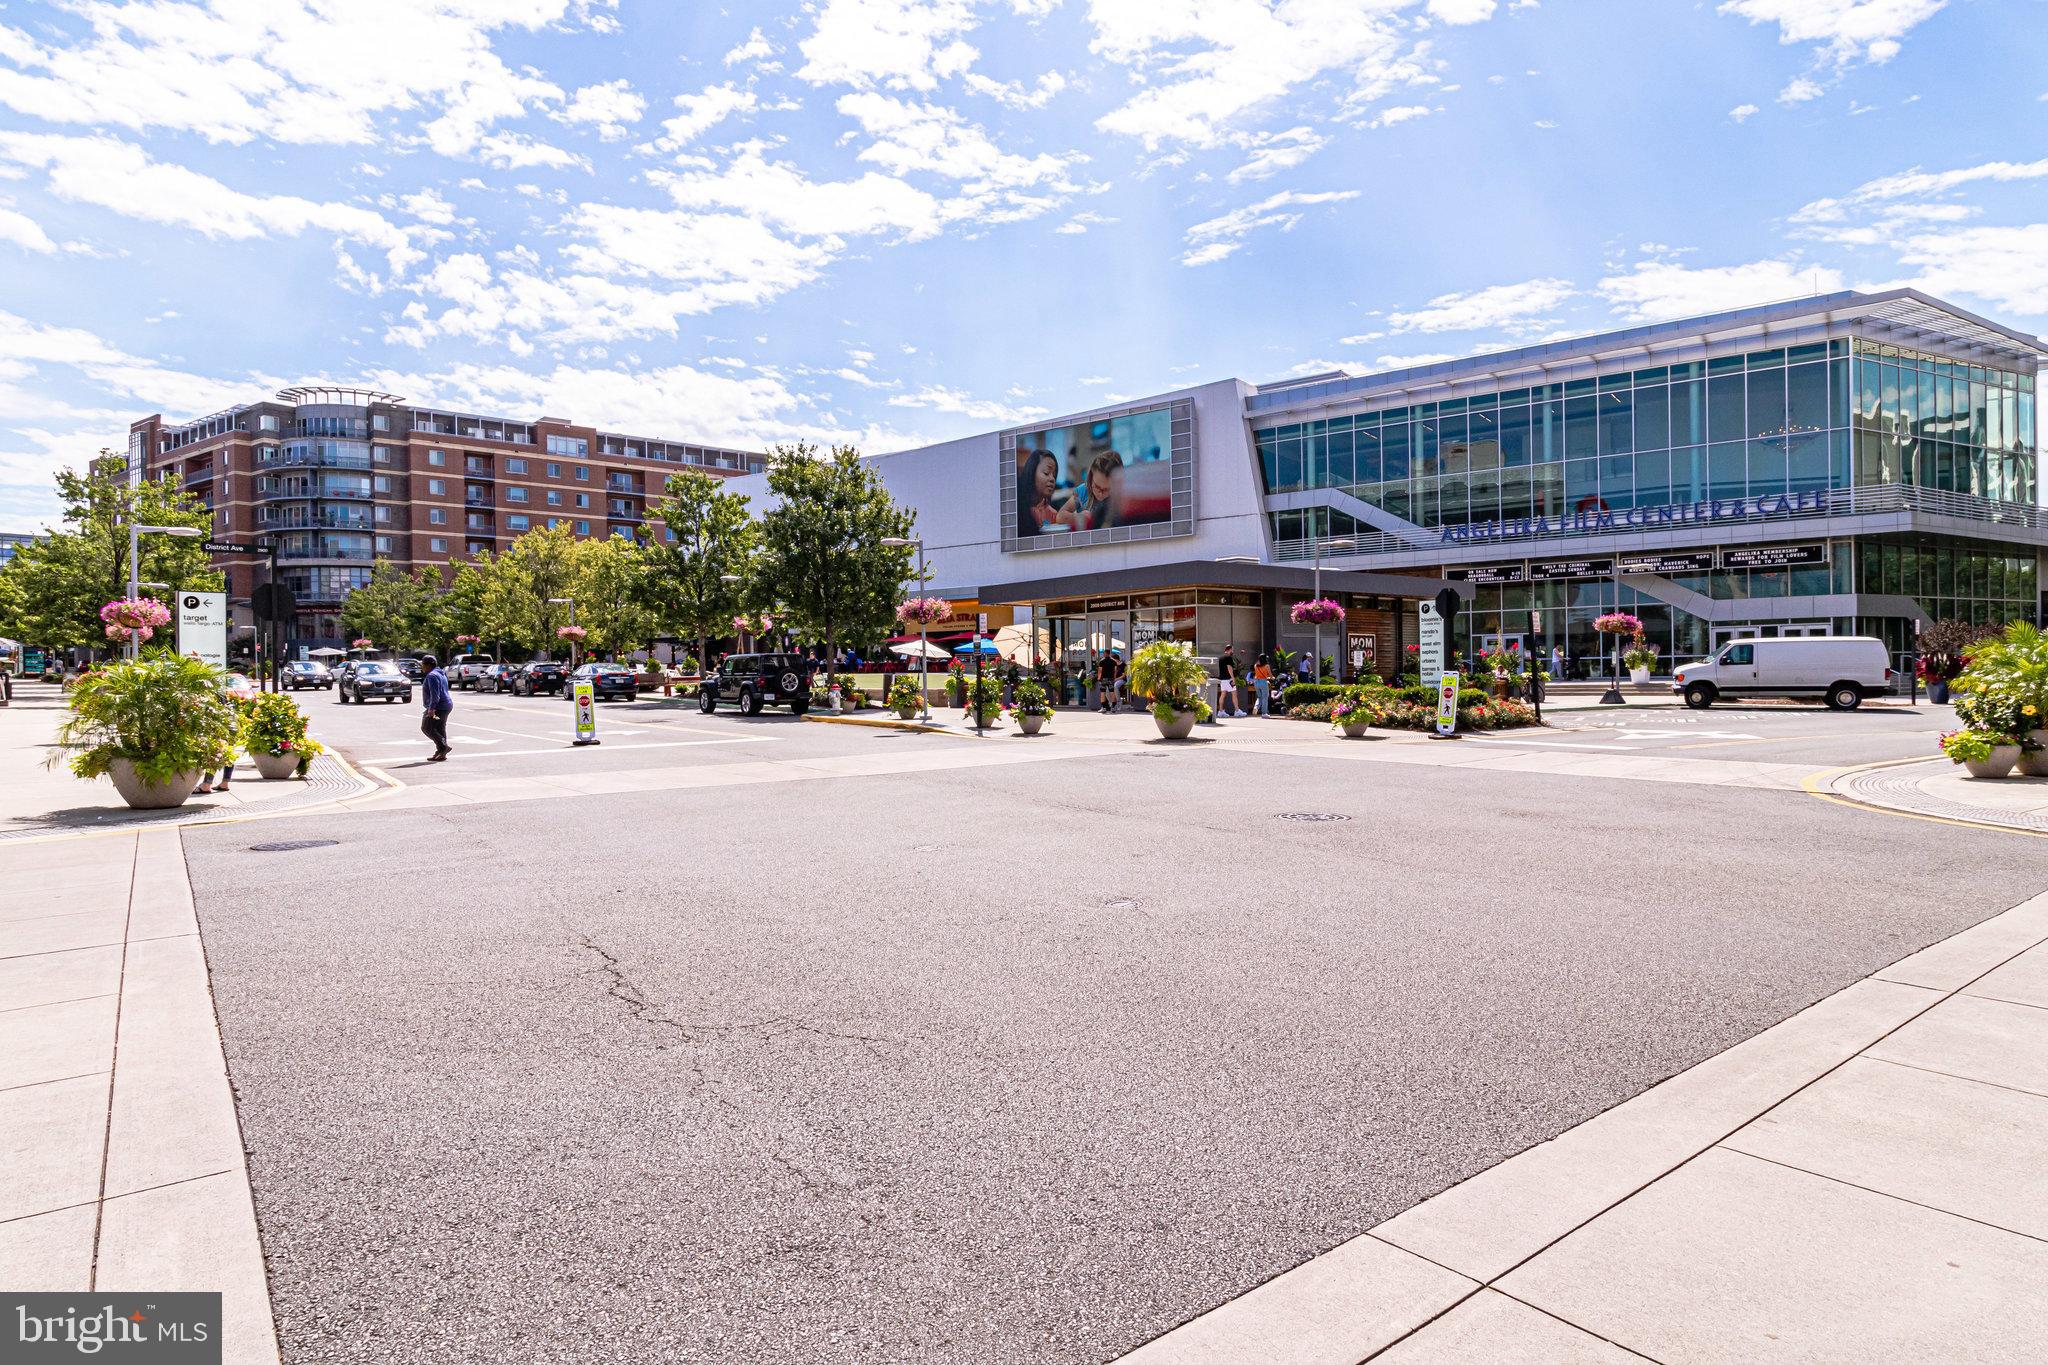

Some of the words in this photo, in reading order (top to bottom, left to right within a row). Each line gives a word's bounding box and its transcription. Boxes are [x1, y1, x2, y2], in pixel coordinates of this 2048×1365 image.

[1441, 515, 1550, 543] ANGELIKA
[1561, 510, 1615, 533] FILM
[1626, 501, 1722, 527] CENTER
[1732, 500, 1746, 518] &
[205, 543, 230, 552] District
[956, 613, 976, 622] STRA
[1134, 631, 1155, 640] MOM
[1351, 637, 1373, 648] MOM
